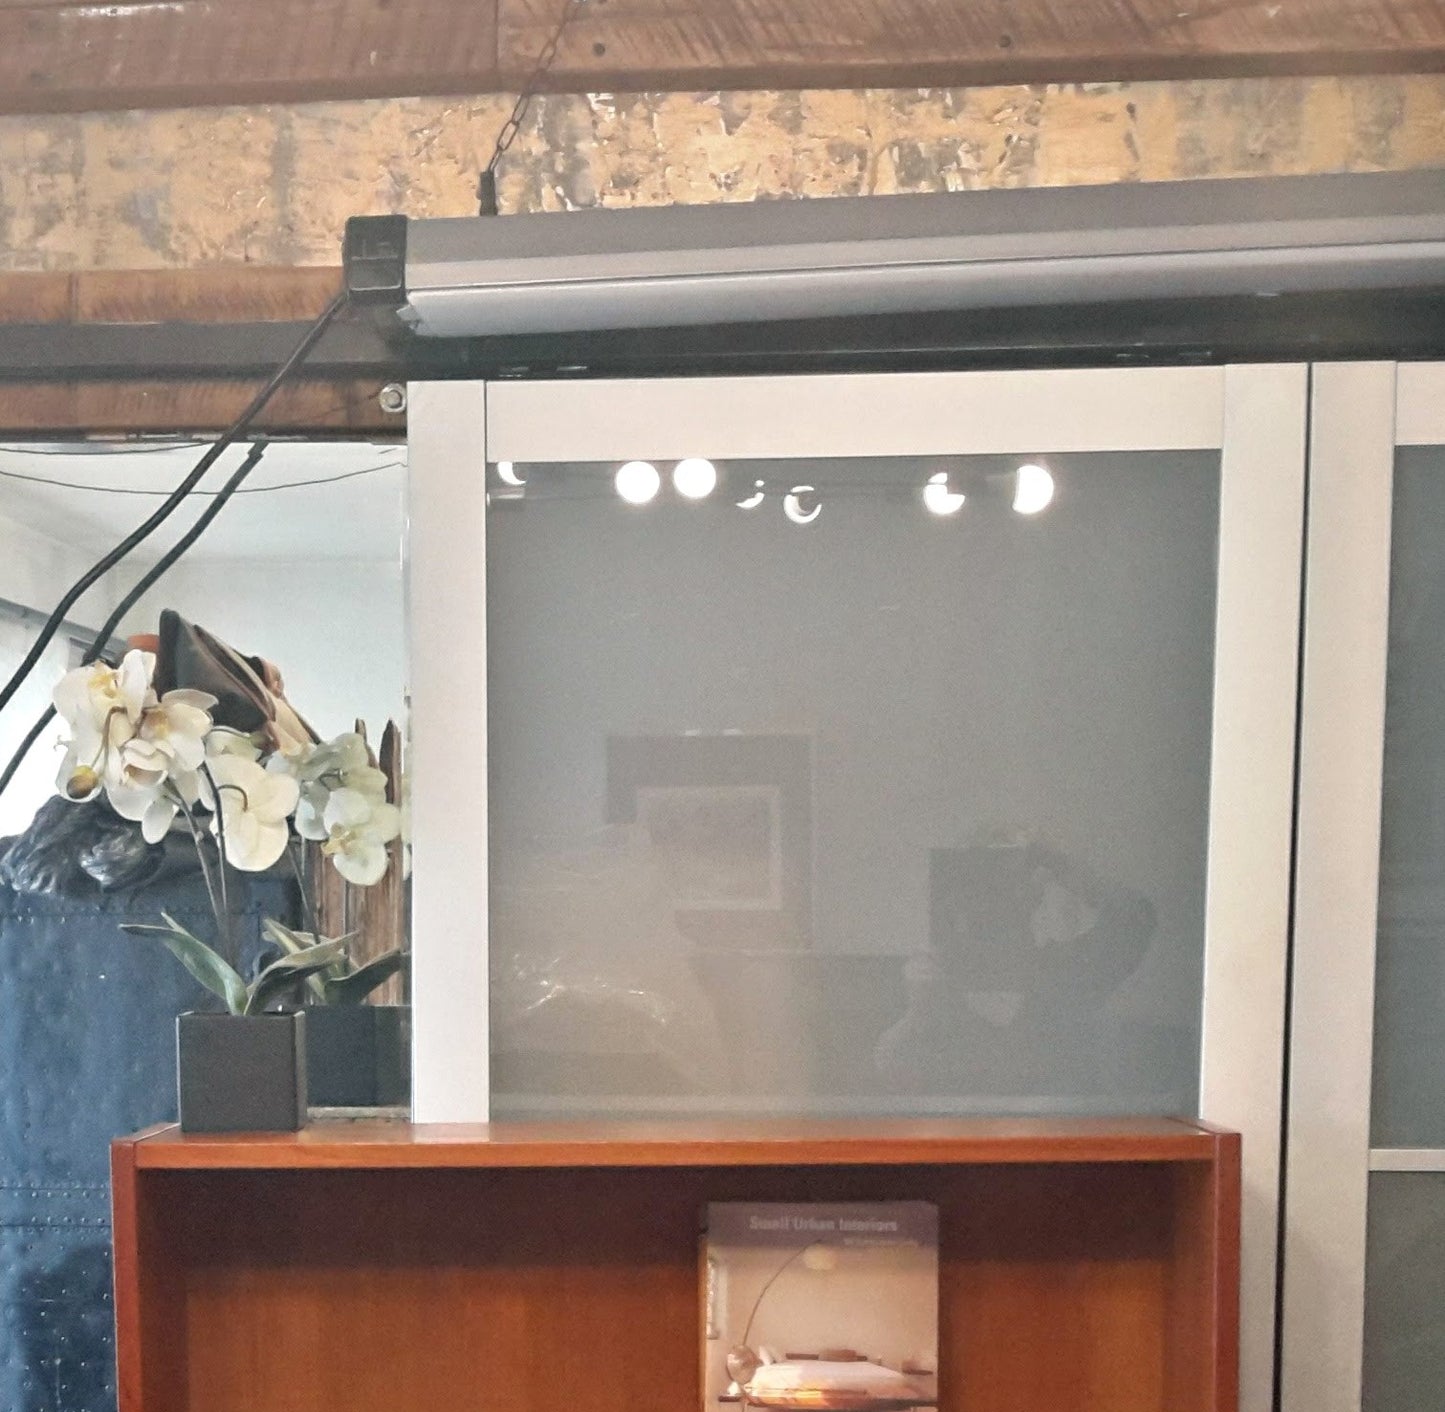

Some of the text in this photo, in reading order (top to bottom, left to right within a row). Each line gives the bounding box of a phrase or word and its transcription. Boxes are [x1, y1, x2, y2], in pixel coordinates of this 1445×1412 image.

[750, 1215, 898, 1232] Small Urban Interiors
